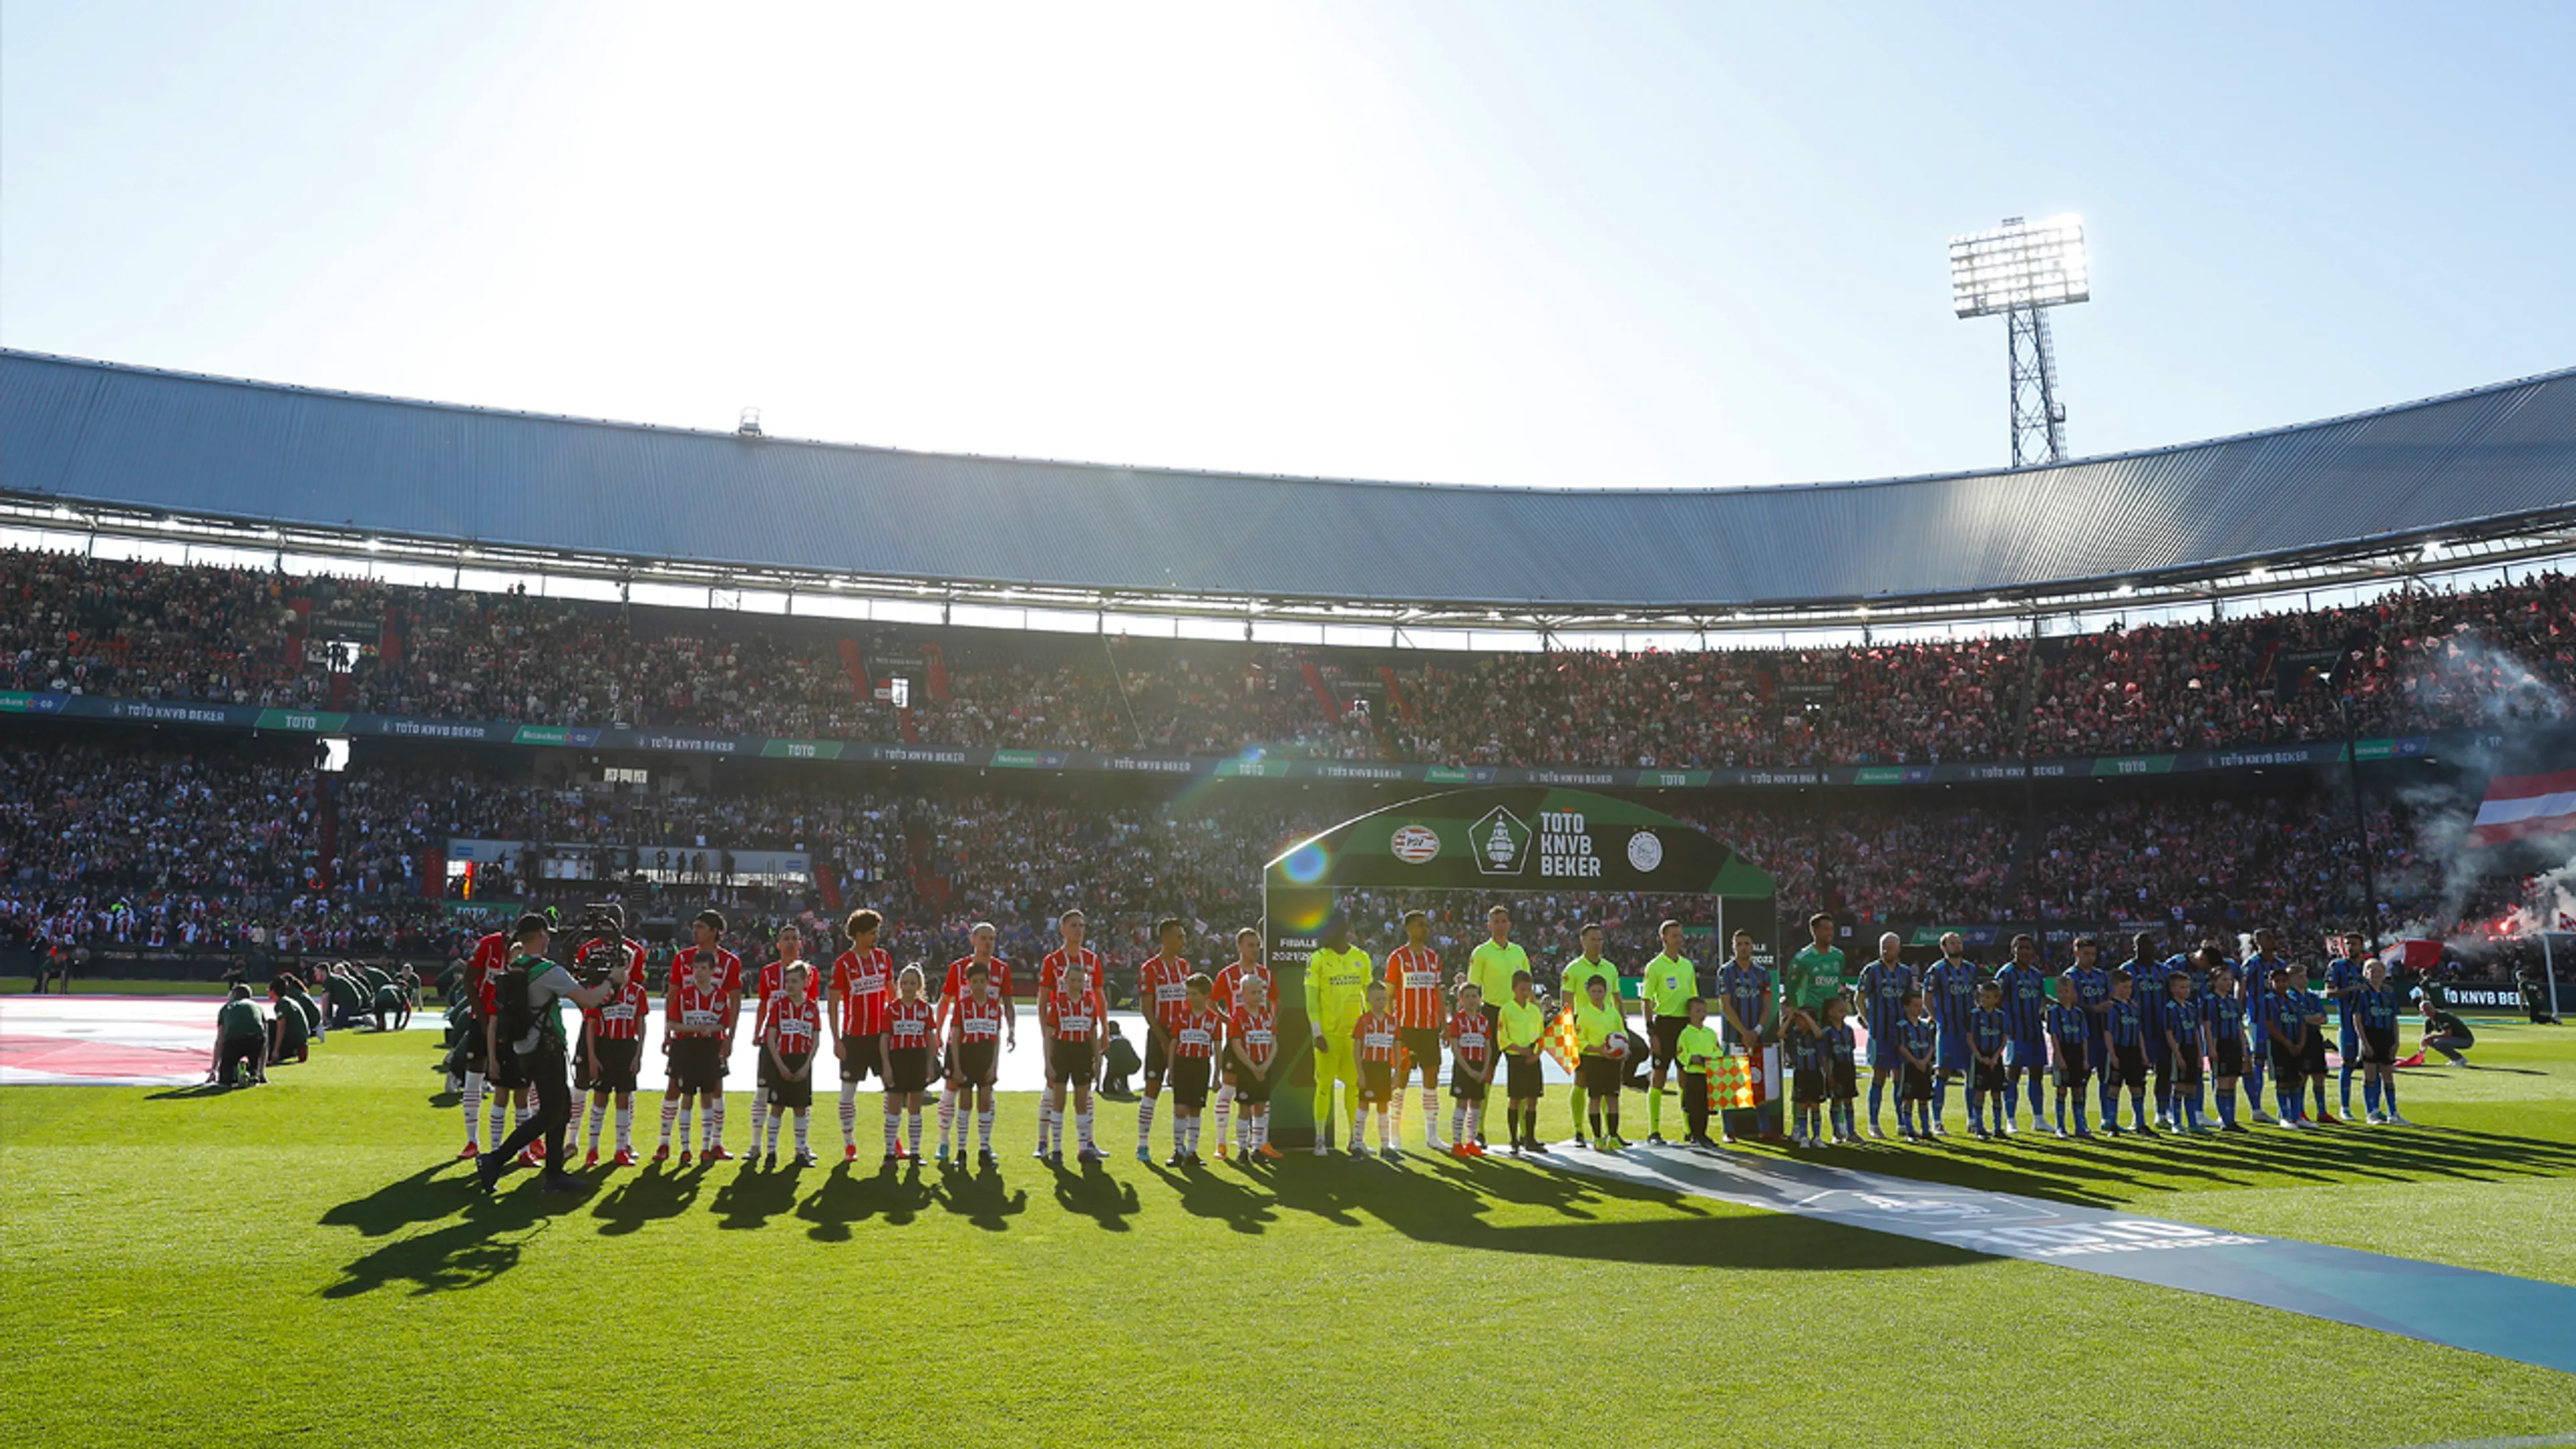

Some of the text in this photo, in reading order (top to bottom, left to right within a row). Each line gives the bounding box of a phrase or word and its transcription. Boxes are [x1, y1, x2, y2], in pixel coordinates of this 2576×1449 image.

[128, 703, 224, 721] TOTO KNVB BEKER
[286, 715, 317, 729] TOTO
[396, 720, 484, 737] TOTO KNVB BEKER
[651, 736, 673, 749] TOTO
[788, 744, 815, 757] TOTO
[885, 747, 906, 759] TOTO
[2220, 753, 2244, 766] TOTO
[2274, 750, 2309, 763] BEKER
[1982, 765, 2004, 778] TOTO
[2006, 767, 2025, 777] KNV
[2118, 761, 2146, 773] TOTO
[1660, 774, 1685, 786] TOTO
[1540, 812, 1585, 834] TOTO
[1541, 834, 1592, 855] KNVB
[1541, 855, 1601, 877] BEKER
[1279, 938, 1318, 948] FINALE
[2459, 989, 2496, 1006] KNVB
